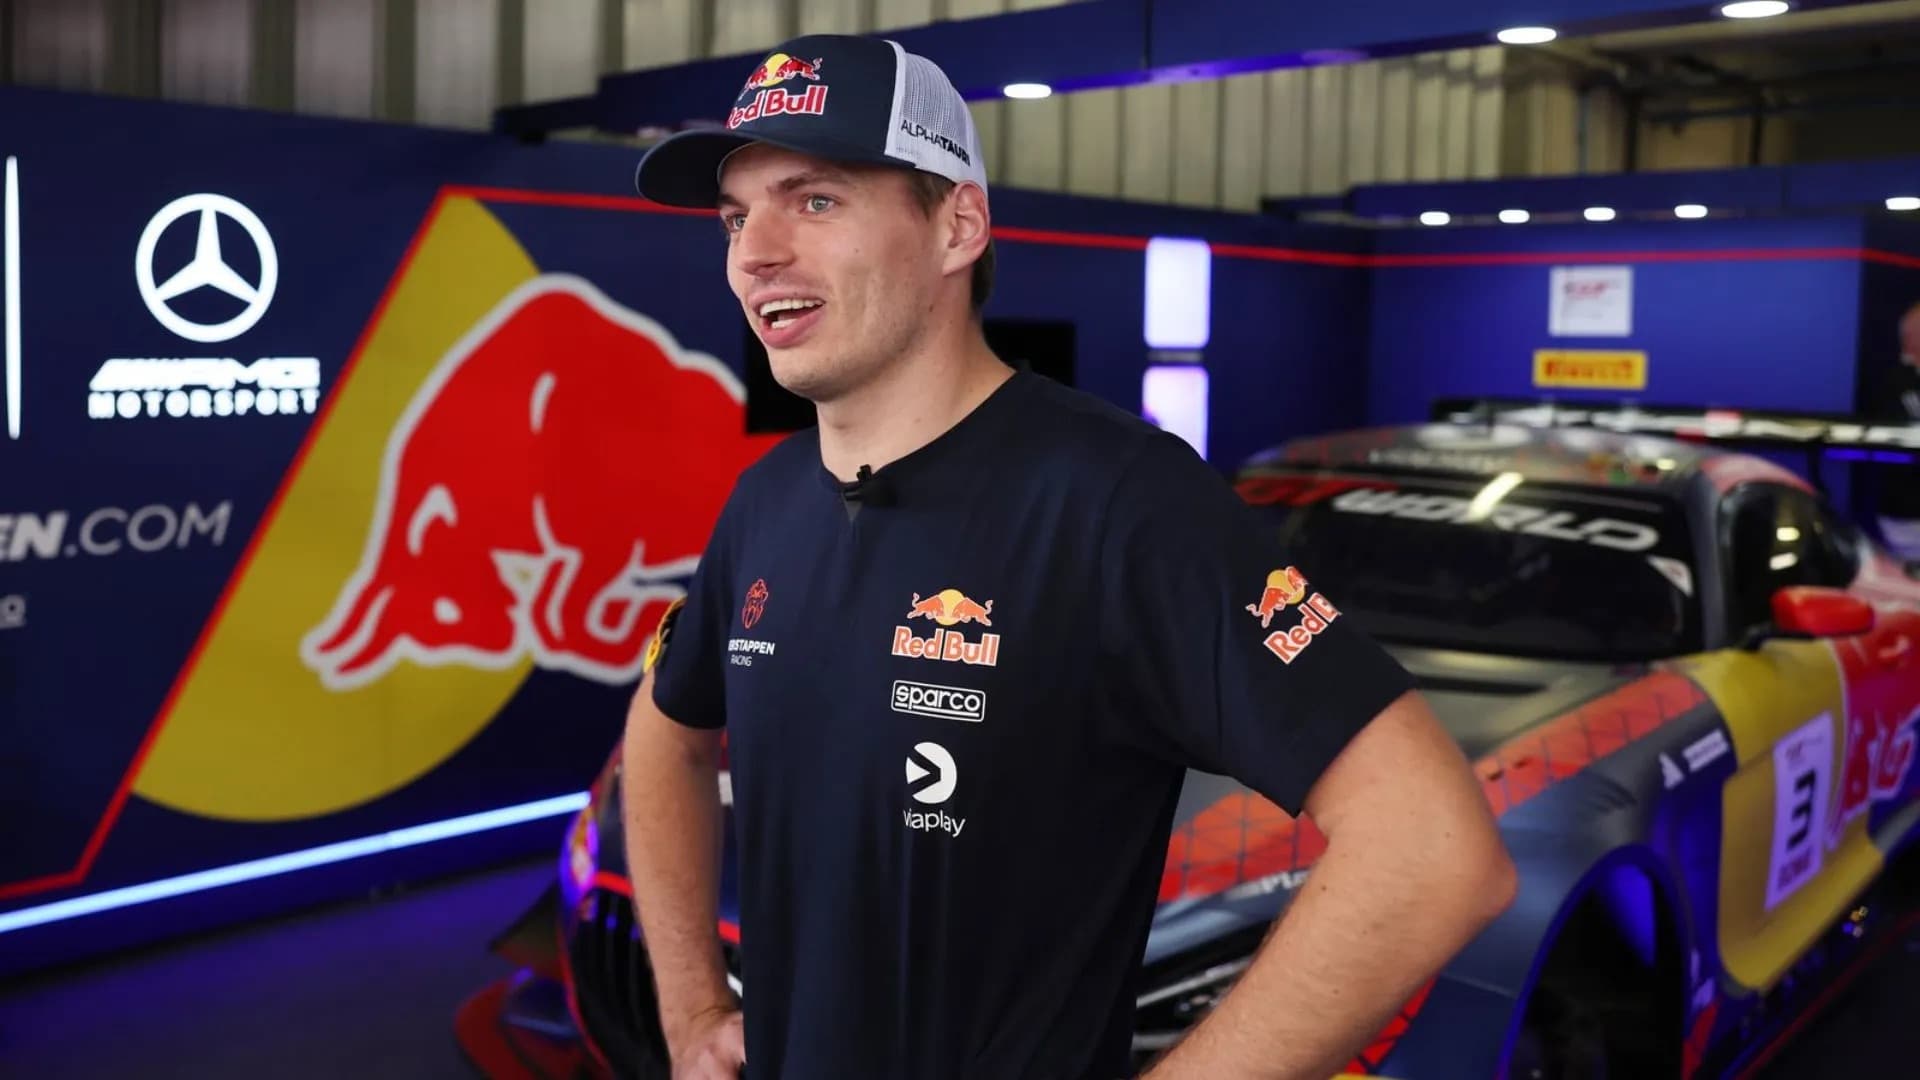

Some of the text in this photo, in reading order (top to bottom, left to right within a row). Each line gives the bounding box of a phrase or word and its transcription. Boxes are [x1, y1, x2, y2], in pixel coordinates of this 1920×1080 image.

[762, 84, 829, 117] Bull
[901, 119, 971, 167] ALPHATAURI
[88, 388, 321, 419] MOTORSPORT
[1333, 488, 1660, 552] WORLD
[891, 625, 1001, 667] Red Bull
[1263, 603, 1329, 665] Red
[894, 684, 982, 713] sparco
[903, 808, 966, 838] viaplay
[1786, 768, 1817, 852] 3
